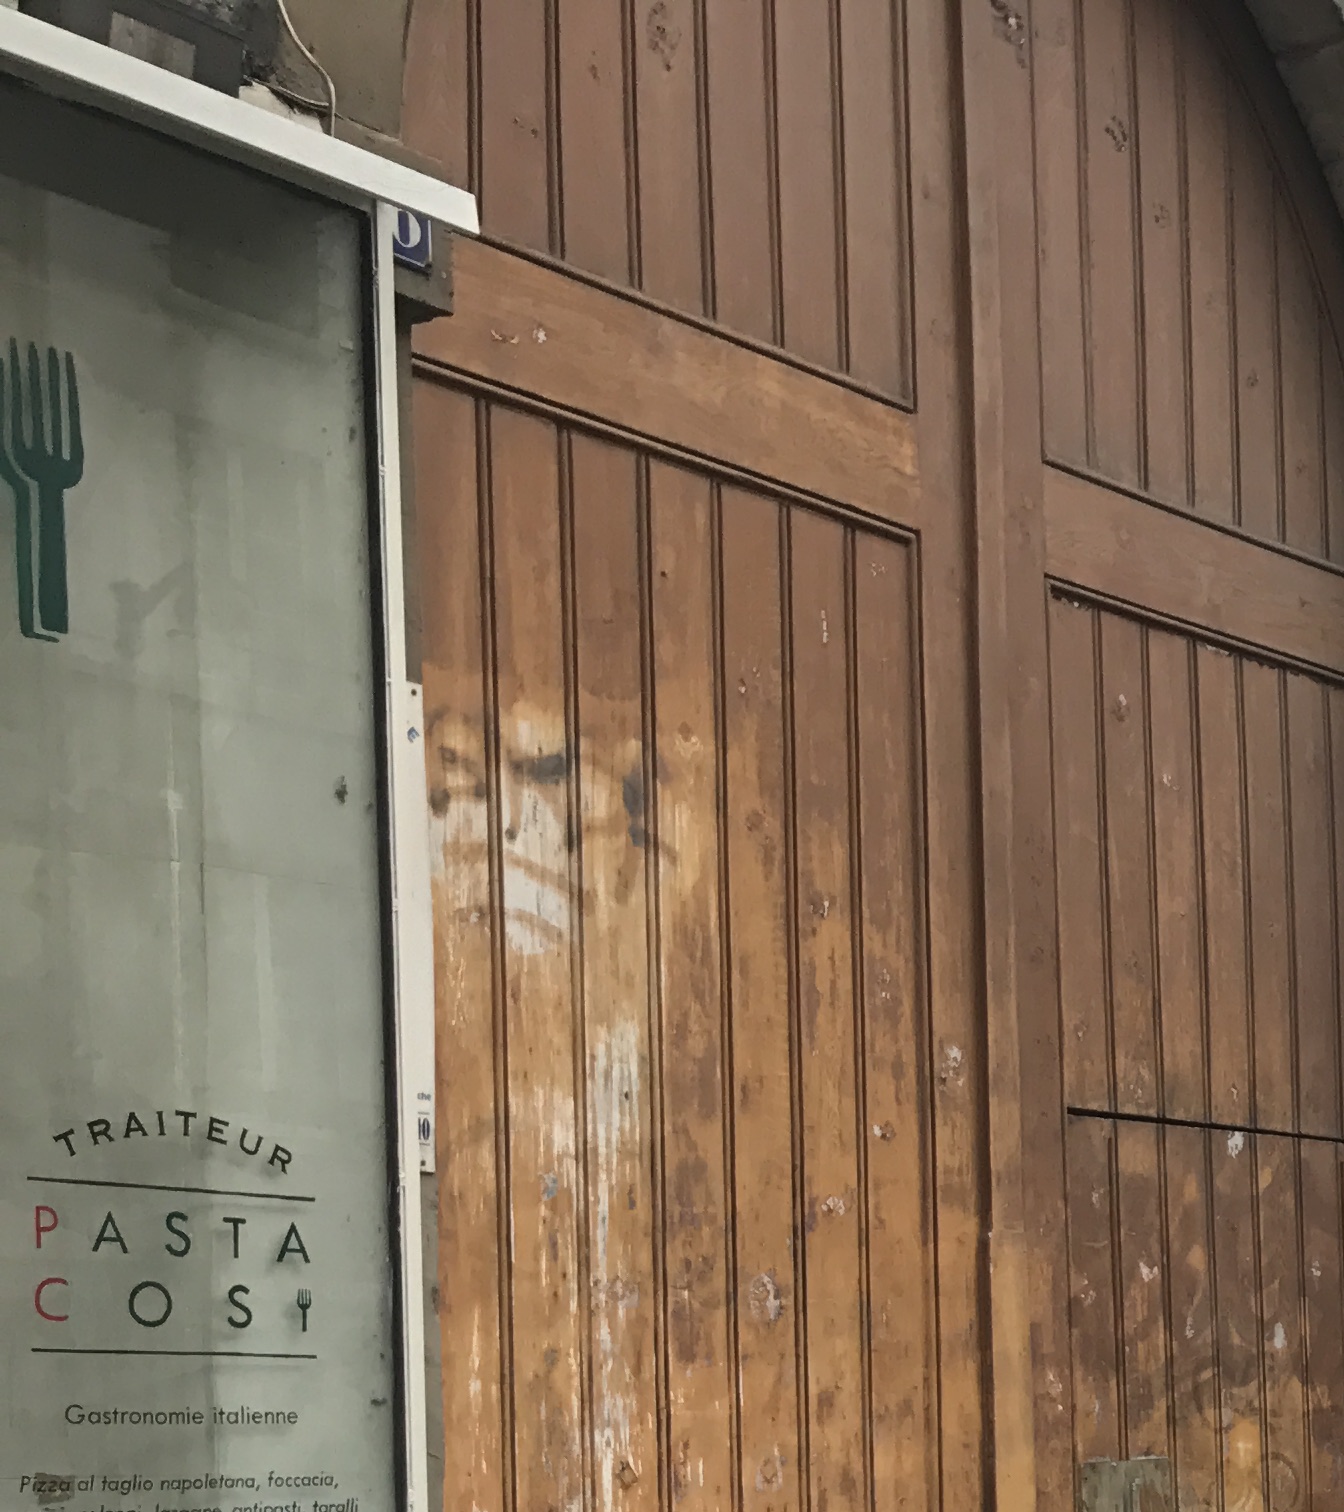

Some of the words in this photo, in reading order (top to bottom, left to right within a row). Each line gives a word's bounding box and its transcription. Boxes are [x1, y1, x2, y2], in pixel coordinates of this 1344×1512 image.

[53, 1109, 292, 1174] TRAITEUR
[34, 1205, 311, 1264] PASTA
[64, 1403, 204, 1425] Gastronomie
[213, 1406, 299, 1425] italienne
[20, 1474, 70, 1493] Pizza
[77, 1474, 94, 1492] al
[101, 1474, 153, 1496] taglio
[160, 1473, 261, 1495] napoletana,
[267, 1471, 339, 1490] foccacia,
